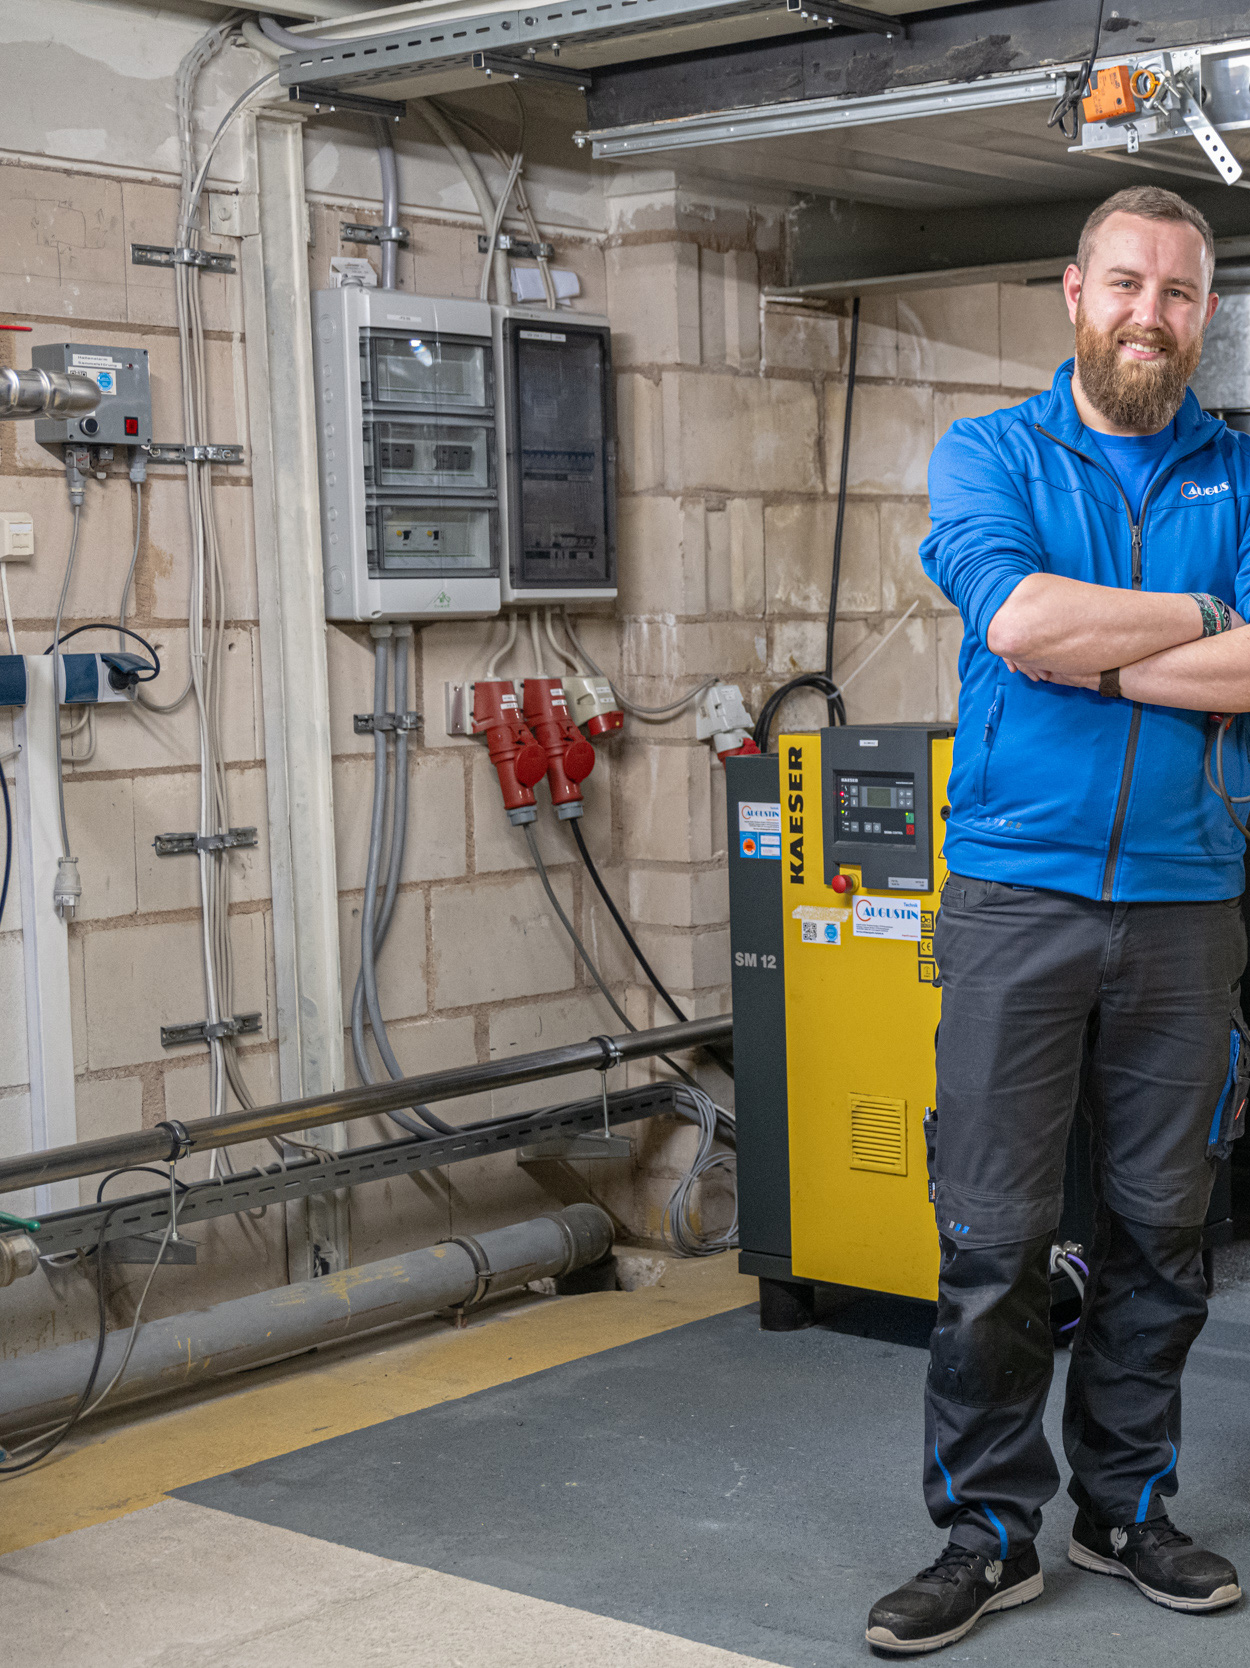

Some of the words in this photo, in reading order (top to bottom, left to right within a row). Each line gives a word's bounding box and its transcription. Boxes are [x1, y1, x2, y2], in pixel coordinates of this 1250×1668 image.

[1188, 480, 1231, 496] AUGUS
[788, 746, 804, 885] KAESER
[864, 907, 918, 920] AUGUSTIN
[734, 952, 758, 968] SM
[760, 954, 777, 969] 12
